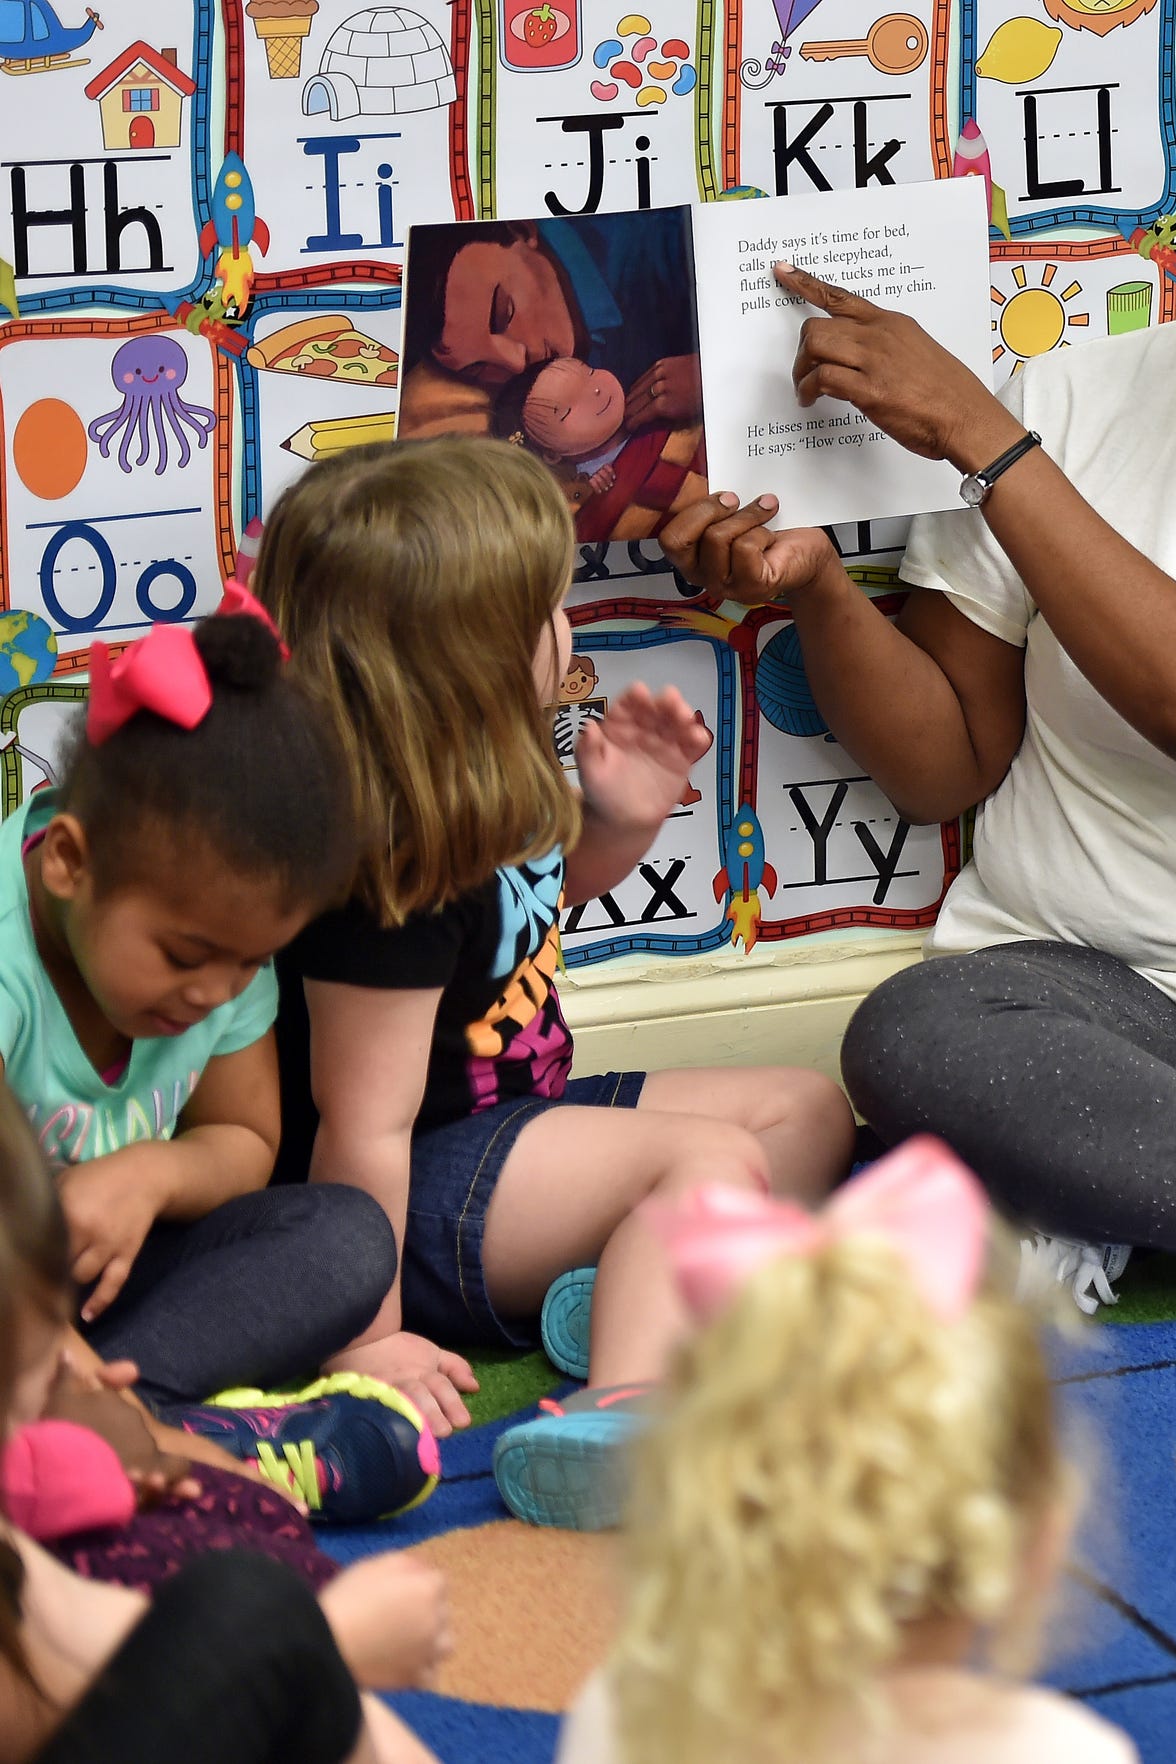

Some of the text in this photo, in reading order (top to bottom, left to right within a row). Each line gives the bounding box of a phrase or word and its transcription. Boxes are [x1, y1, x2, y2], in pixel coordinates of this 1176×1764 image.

[773, 101, 902, 196] Kk
[1023, 86, 1111, 195] Ll
[303, 138, 393, 249] Ii
[10, 161, 165, 278] Hh
[738, 237, 778, 254] Daddy
[782, 236, 807, 251] says
[832, 229, 859, 244] time
[863, 227, 880, 240] for
[884, 224, 910, 238] bed,
[738, 258, 766, 272] calls
[792, 252, 819, 270] little
[823, 245, 893, 265] sleepyhead,
[740, 277, 771, 291] fluffs
[841, 267, 873, 281] tucks
[877, 265, 896, 277] me
[741, 297, 771, 314] pulls
[885, 284, 902, 298] my
[907, 279, 936, 293] chin.
[747, 425, 765, 438] He
[768, 422, 802, 436] kisses
[806, 419, 825, 430] me
[828, 413, 850, 427] and
[748, 445, 765, 457] He
[768, 442, 796, 456] says:
[838, 434, 864, 447] cozy
[789, 782, 911, 905] Yy
